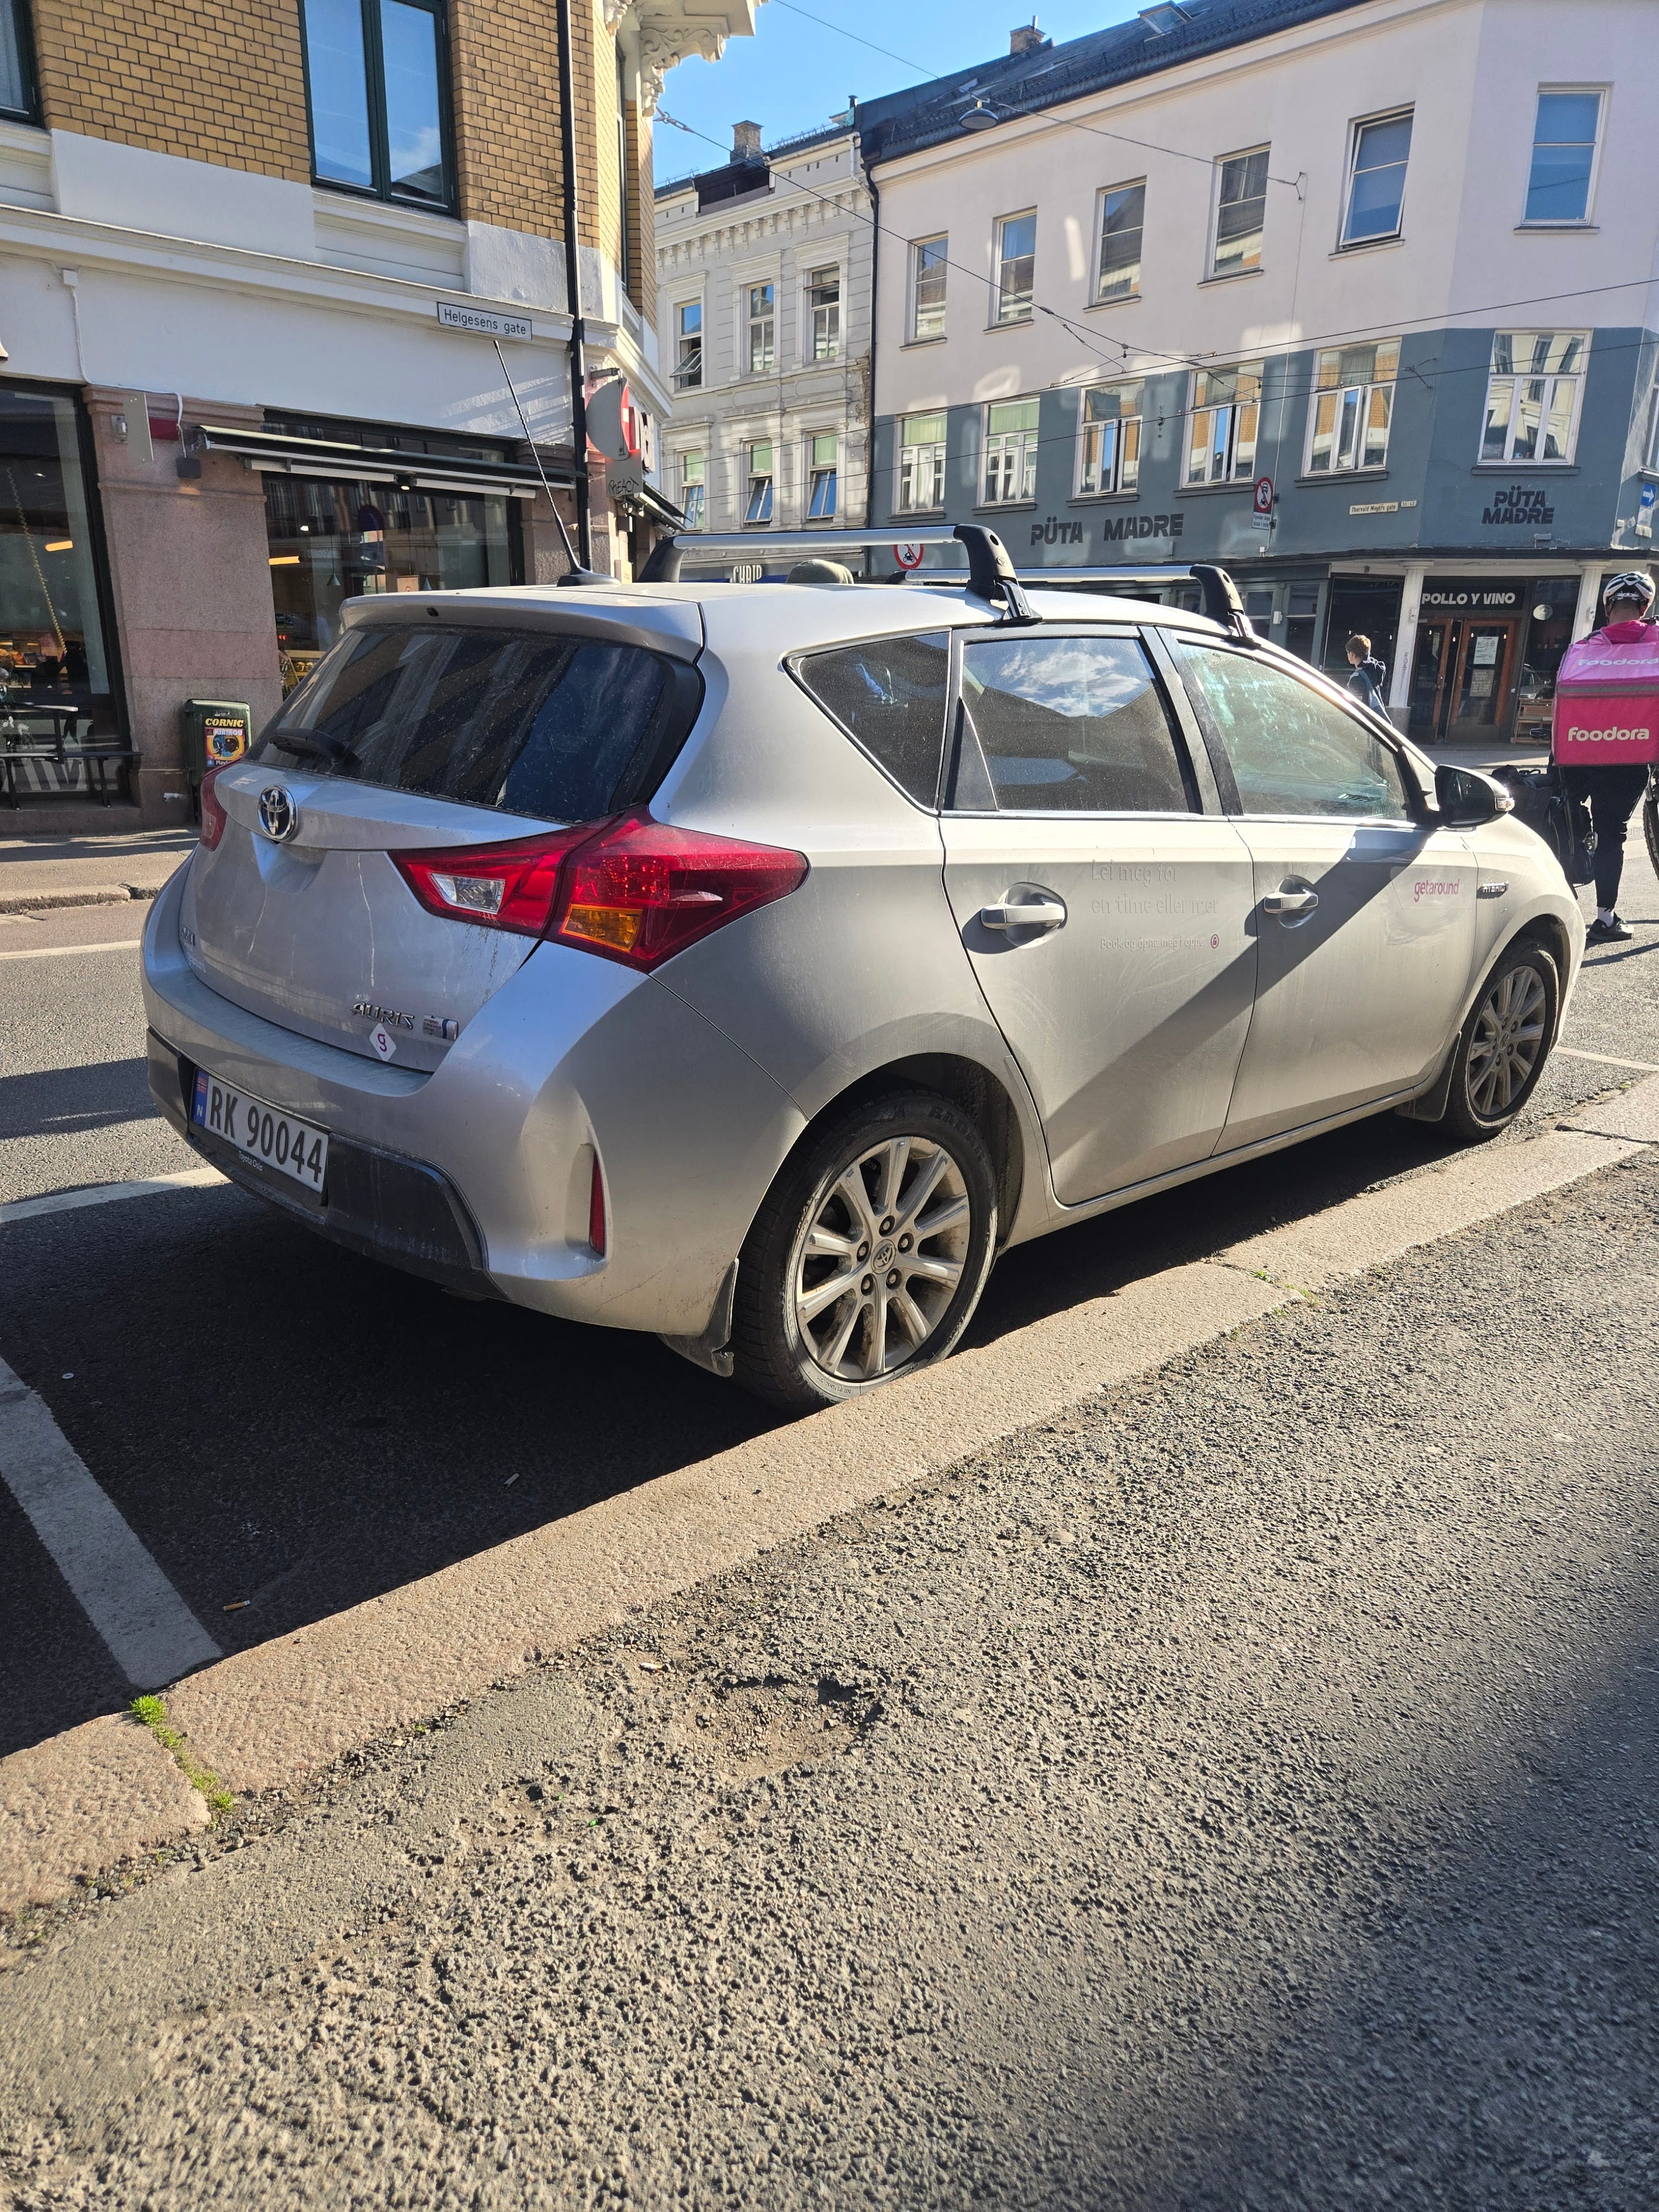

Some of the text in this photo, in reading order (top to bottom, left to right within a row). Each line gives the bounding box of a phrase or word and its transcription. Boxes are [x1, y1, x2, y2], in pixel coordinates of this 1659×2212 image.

[444, 309, 526, 335] Helgesens gate
[1494, 485, 1546, 508] PÜTA
[1481, 507, 1555, 524] MADRE
[1030, 513, 1184, 545] PÜTA MADRE
[1421, 592, 1516, 604] POLLO Y VINO
[1578, 658, 1659, 666] foodora
[205, 718, 244, 727] CORNIC
[1568, 726, 1650, 742] foodora
[1092, 859, 1114, 880] Lei
[1119, 865, 1151, 888] meg
[1413, 879, 1460, 902] getaround
[1092, 899, 1110, 914] en
[1115, 893, 1151, 914] time
[1156, 893, 1186, 914] eller
[1100, 937, 1121, 950] Book
[1124, 940, 1135, 952] og
[1137, 937, 1159, 951] åpne
[1160, 940, 1178, 951] meg
[351, 1002, 415, 1031] AURIS
[196, 1104, 203, 1117] N
[210, 1086, 322, 1183] RK 90044
[238, 1150, 263, 1172] Toyota Oslo
